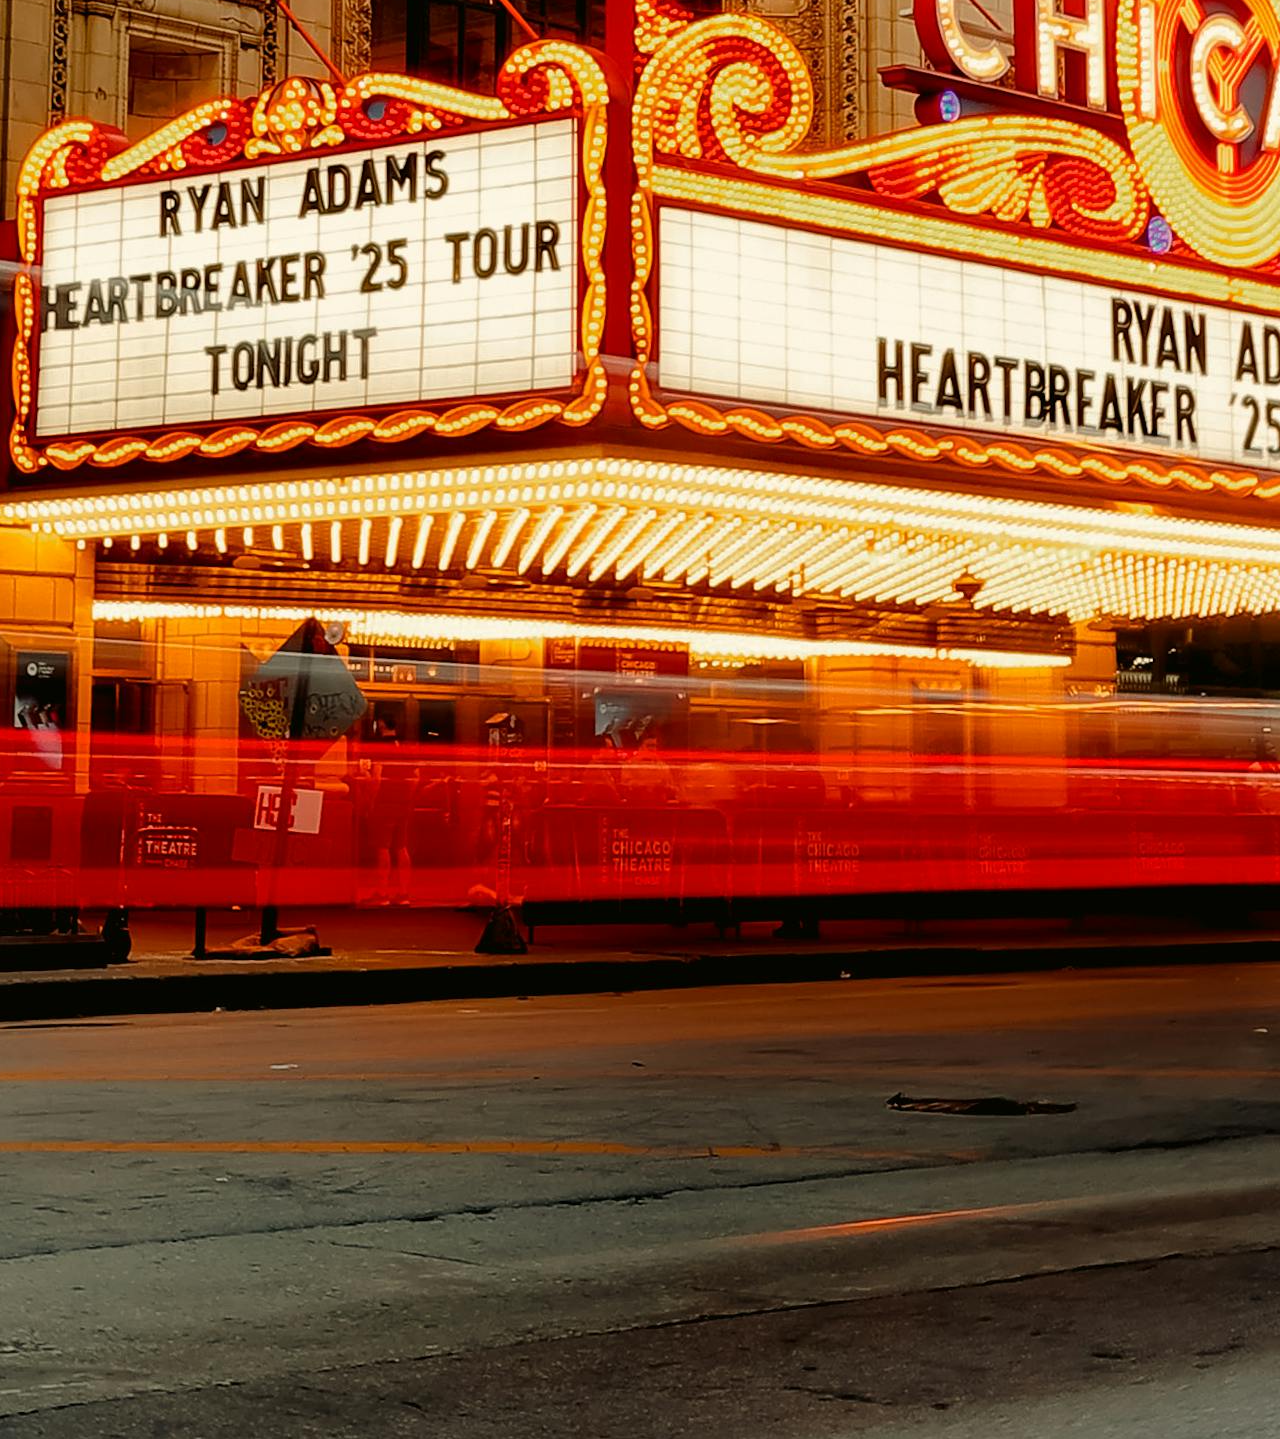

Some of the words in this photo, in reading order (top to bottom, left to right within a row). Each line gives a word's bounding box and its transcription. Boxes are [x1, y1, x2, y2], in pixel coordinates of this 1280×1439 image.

[159, 177, 265, 237] RYAN
[298, 150, 450, 219] ADAMS
[40, 251, 326, 332] HEARTBREAKER
[350, 239, 409, 293] '25
[445, 221, 561, 284] TOUR
[1110, 296, 1208, 376] RYAN
[205, 327, 378, 395] TONIGHT
[876, 336, 1197, 448] HEARTBREAKER
[145, 840, 197, 856] THEATRE
[612, 840, 671, 855] CHICAGO
[612, 857, 671, 872] THEATRE
[807, 842, 860, 857] CHICAGO
[807, 860, 860, 873] THEATRE
